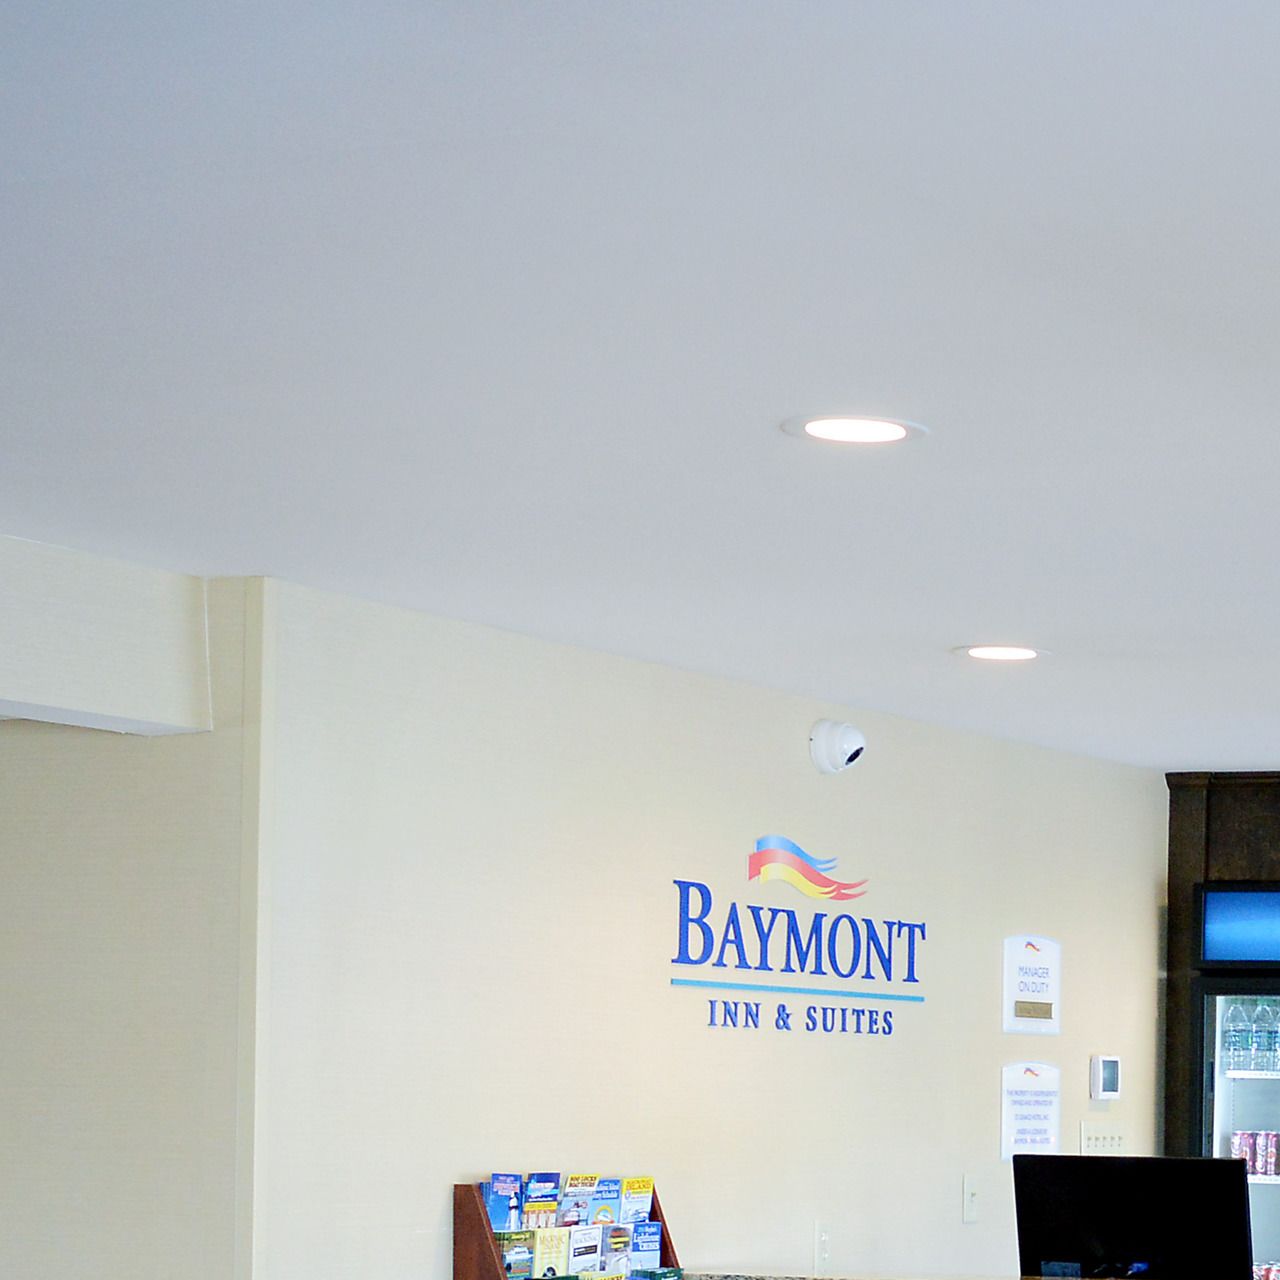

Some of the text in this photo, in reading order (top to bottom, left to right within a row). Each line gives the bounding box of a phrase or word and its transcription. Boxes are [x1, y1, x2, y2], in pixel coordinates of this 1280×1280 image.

[671, 879, 927, 983] BAYMONT
[708, 999, 894, 1036] INN & SUITES
